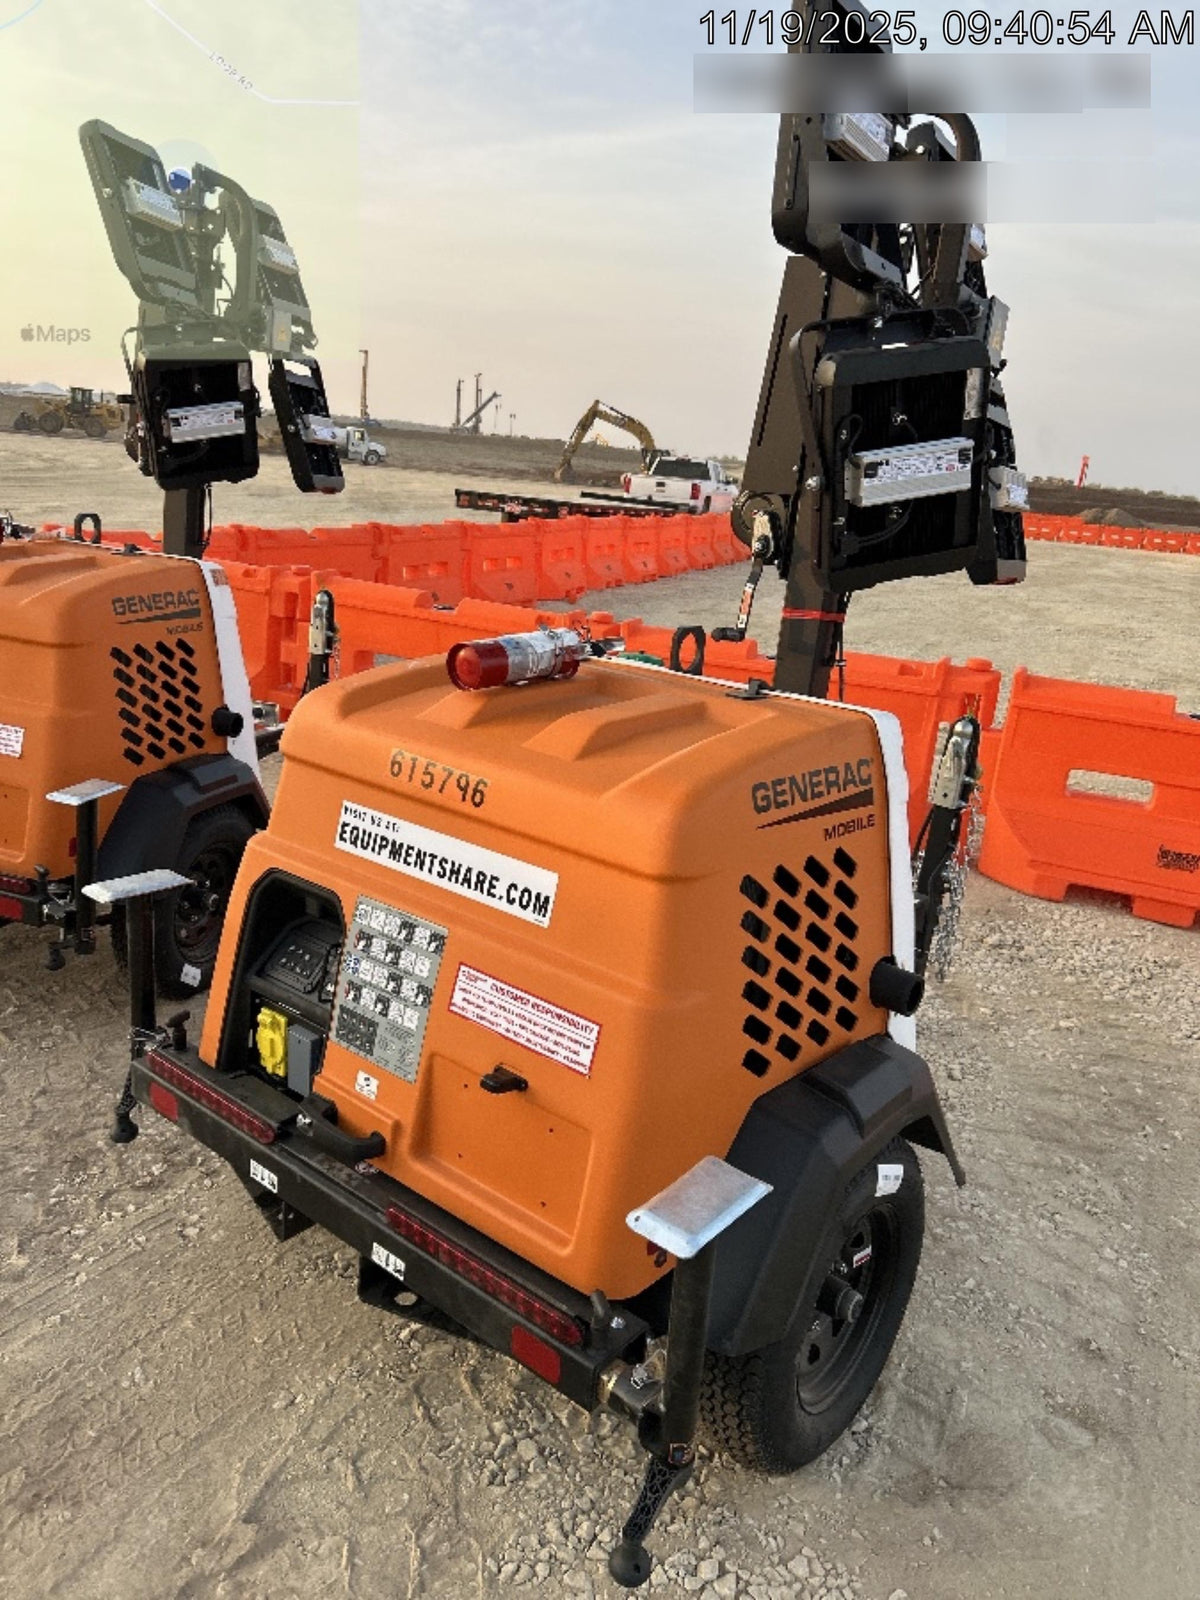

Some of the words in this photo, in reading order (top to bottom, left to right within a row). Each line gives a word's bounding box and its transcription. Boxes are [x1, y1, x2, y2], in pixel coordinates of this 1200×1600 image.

[112, 588, 200, 616] GENERAC
[390, 749, 488, 808] 615796
[751, 758, 873, 815] GENERAC
[823, 813, 876, 841] MOBILE
[338, 820, 551, 919] EQUIPMENTSHARE.COM
